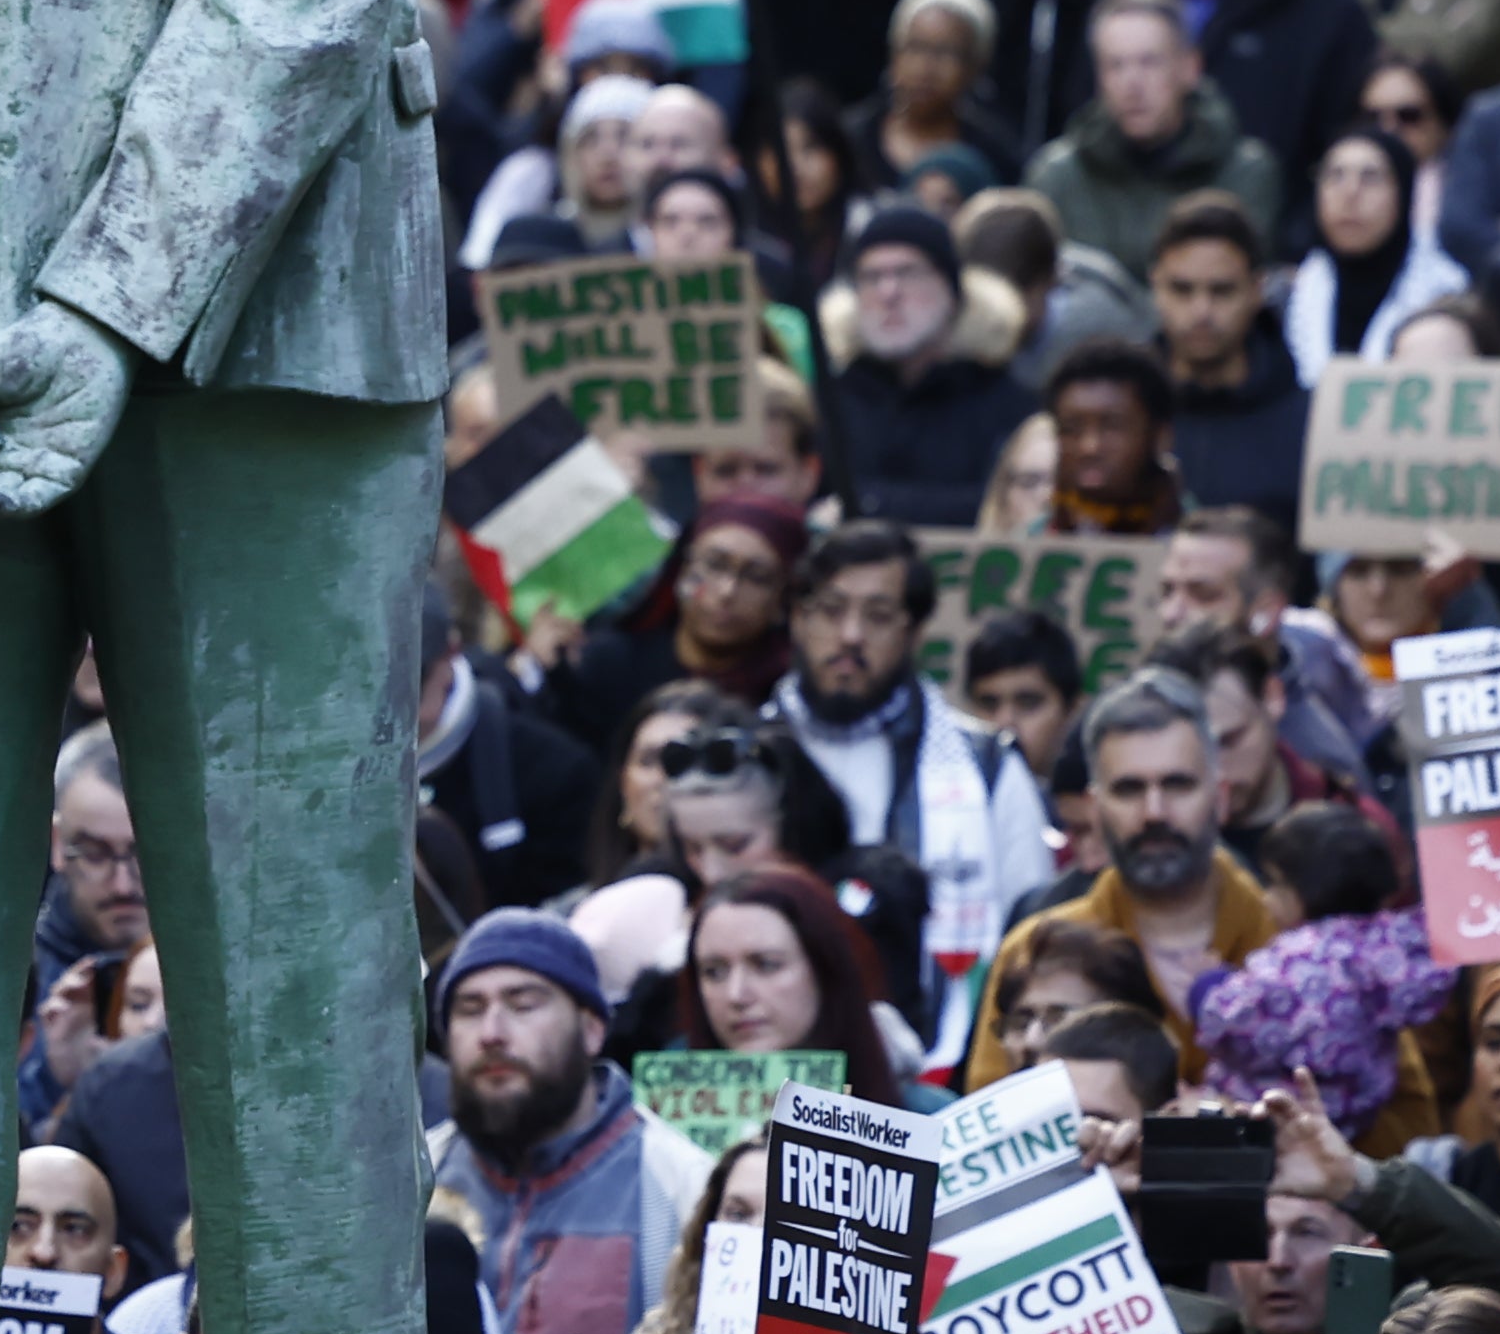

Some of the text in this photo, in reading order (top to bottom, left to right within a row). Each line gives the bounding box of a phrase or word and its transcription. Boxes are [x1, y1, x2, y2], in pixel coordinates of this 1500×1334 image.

[494, 262, 744, 327] PALESTINE
[522, 318, 745, 377] WILL BE
[571, 371, 745, 428] FREE
[792, 1095, 912, 1149] Socialist Worker
[781, 1140, 915, 1235] FREEDOM
[837, 1218, 859, 1253] for
[0, 1279, 60, 1306] orker
